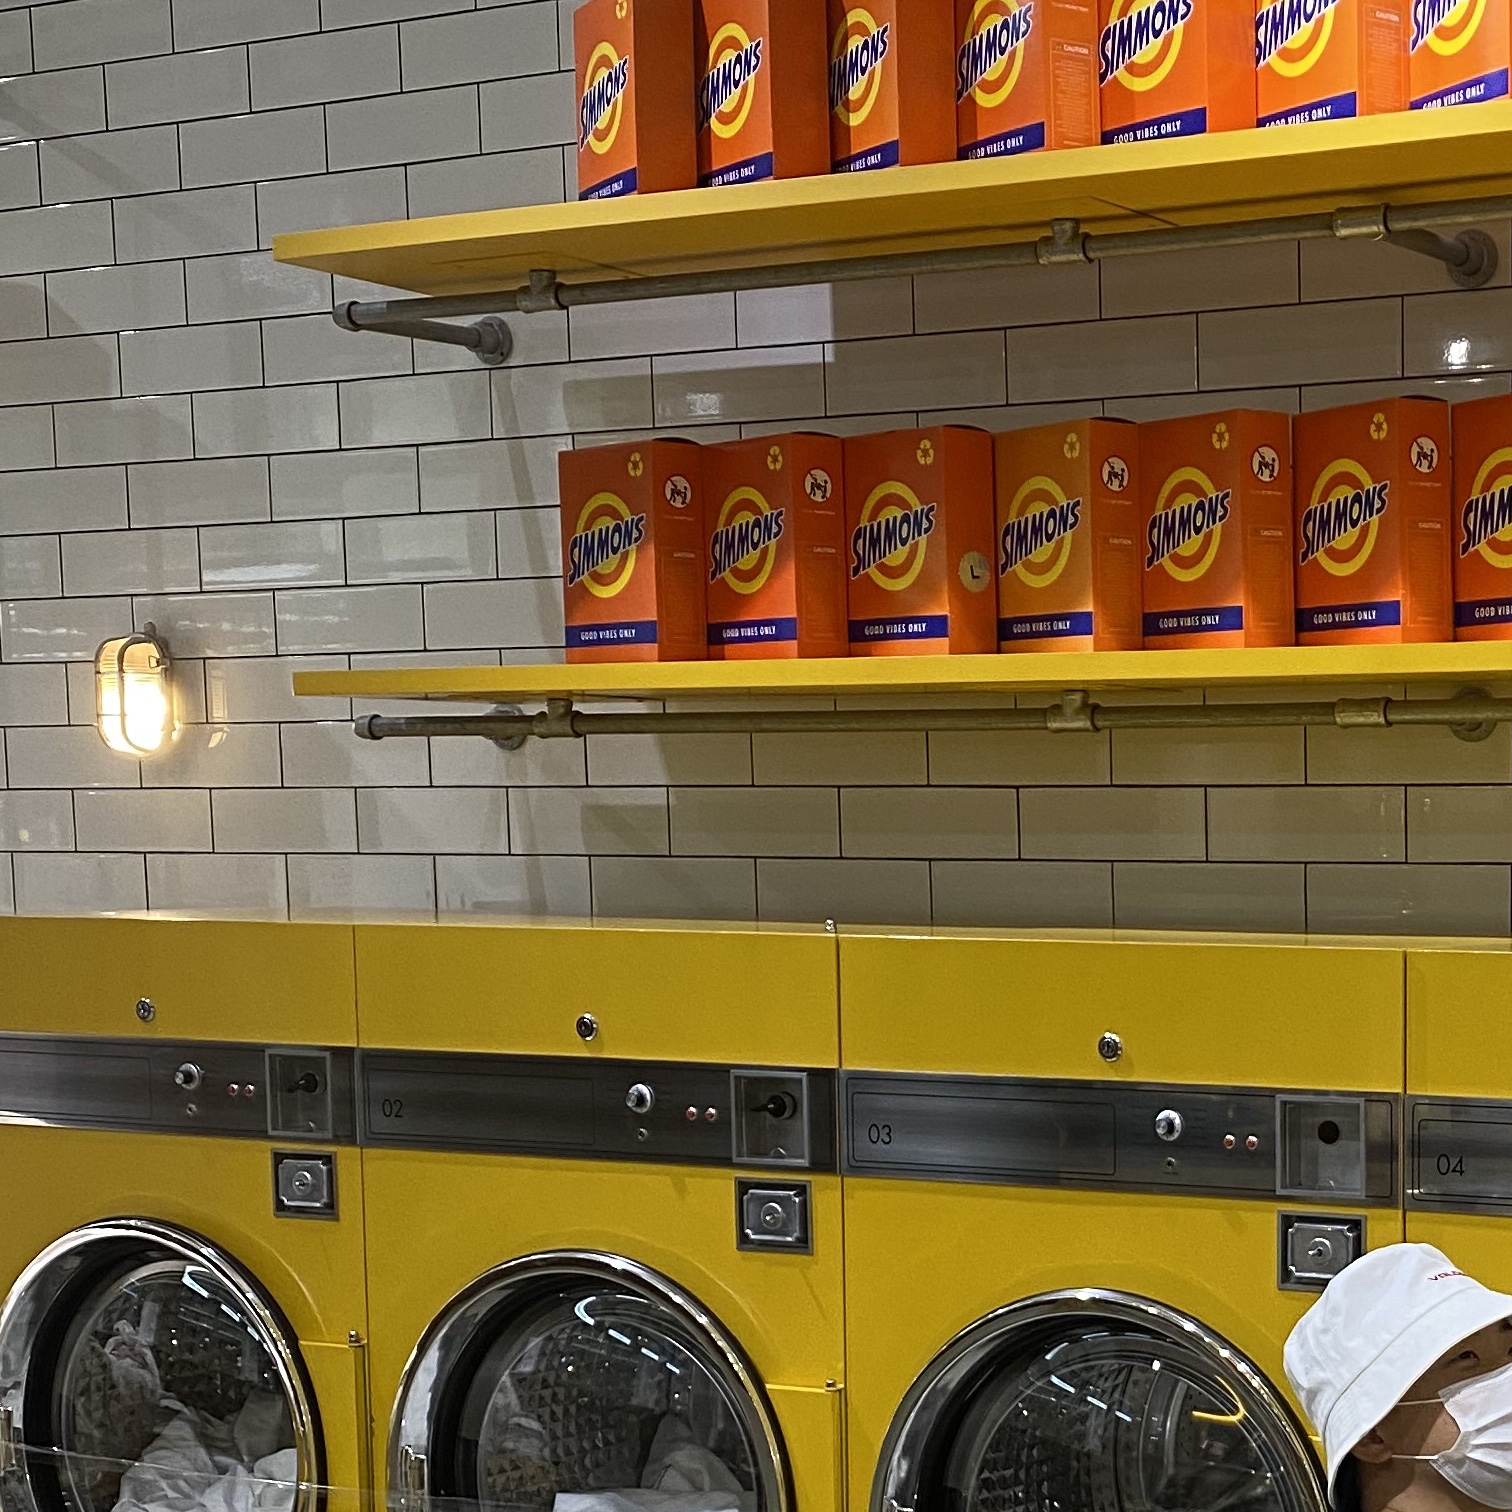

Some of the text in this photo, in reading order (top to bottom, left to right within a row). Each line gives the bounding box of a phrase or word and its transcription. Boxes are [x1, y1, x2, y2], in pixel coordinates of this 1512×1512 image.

[957, 2, 1034, 104] SIMMONS
[829, 22, 889, 115] IMMONS
[698, 37, 762, 134] SIMMONS
[1443, 90, 1464, 106] VIBES
[1465, 83, 1485, 100] ONLY
[579, 55, 629, 152] SIMMONS
[1287, 111, 1310, 125] VIBES
[1311, 105, 1331, 120] ONLY
[1136, 126, 1158, 140] VIBES
[1160, 120, 1181, 134] ONLY
[987, 141, 1005, 155] VIBES
[1006, 136, 1023, 149] ONLY
[867, 153, 881, 167] ONLY
[1146, 489, 1232, 570] SIMMONS
[1300, 481, 1390, 565] SIMMONS
[709, 508, 785, 583] SIMMONS
[852, 503, 937, 579] SIMMONS
[1000, 498, 1082, 577] SIMMONS
[568, 513, 645, 586] SIMMONS
[1201, 615, 1219, 625] ONLY
[1357, 610, 1376, 620] ONLY
[1475, 607, 1495, 618] GOOD
[619, 629, 636, 638] ONLY
[760, 626, 776, 635] ONLY
[908, 623, 927, 633] ONLY
[1053, 620, 1070, 630] ONLY
[382, 1099, 403, 1118] 02
[868, 1123, 892, 1145] 03
[1436, 1153, 1465, 1177] 04
